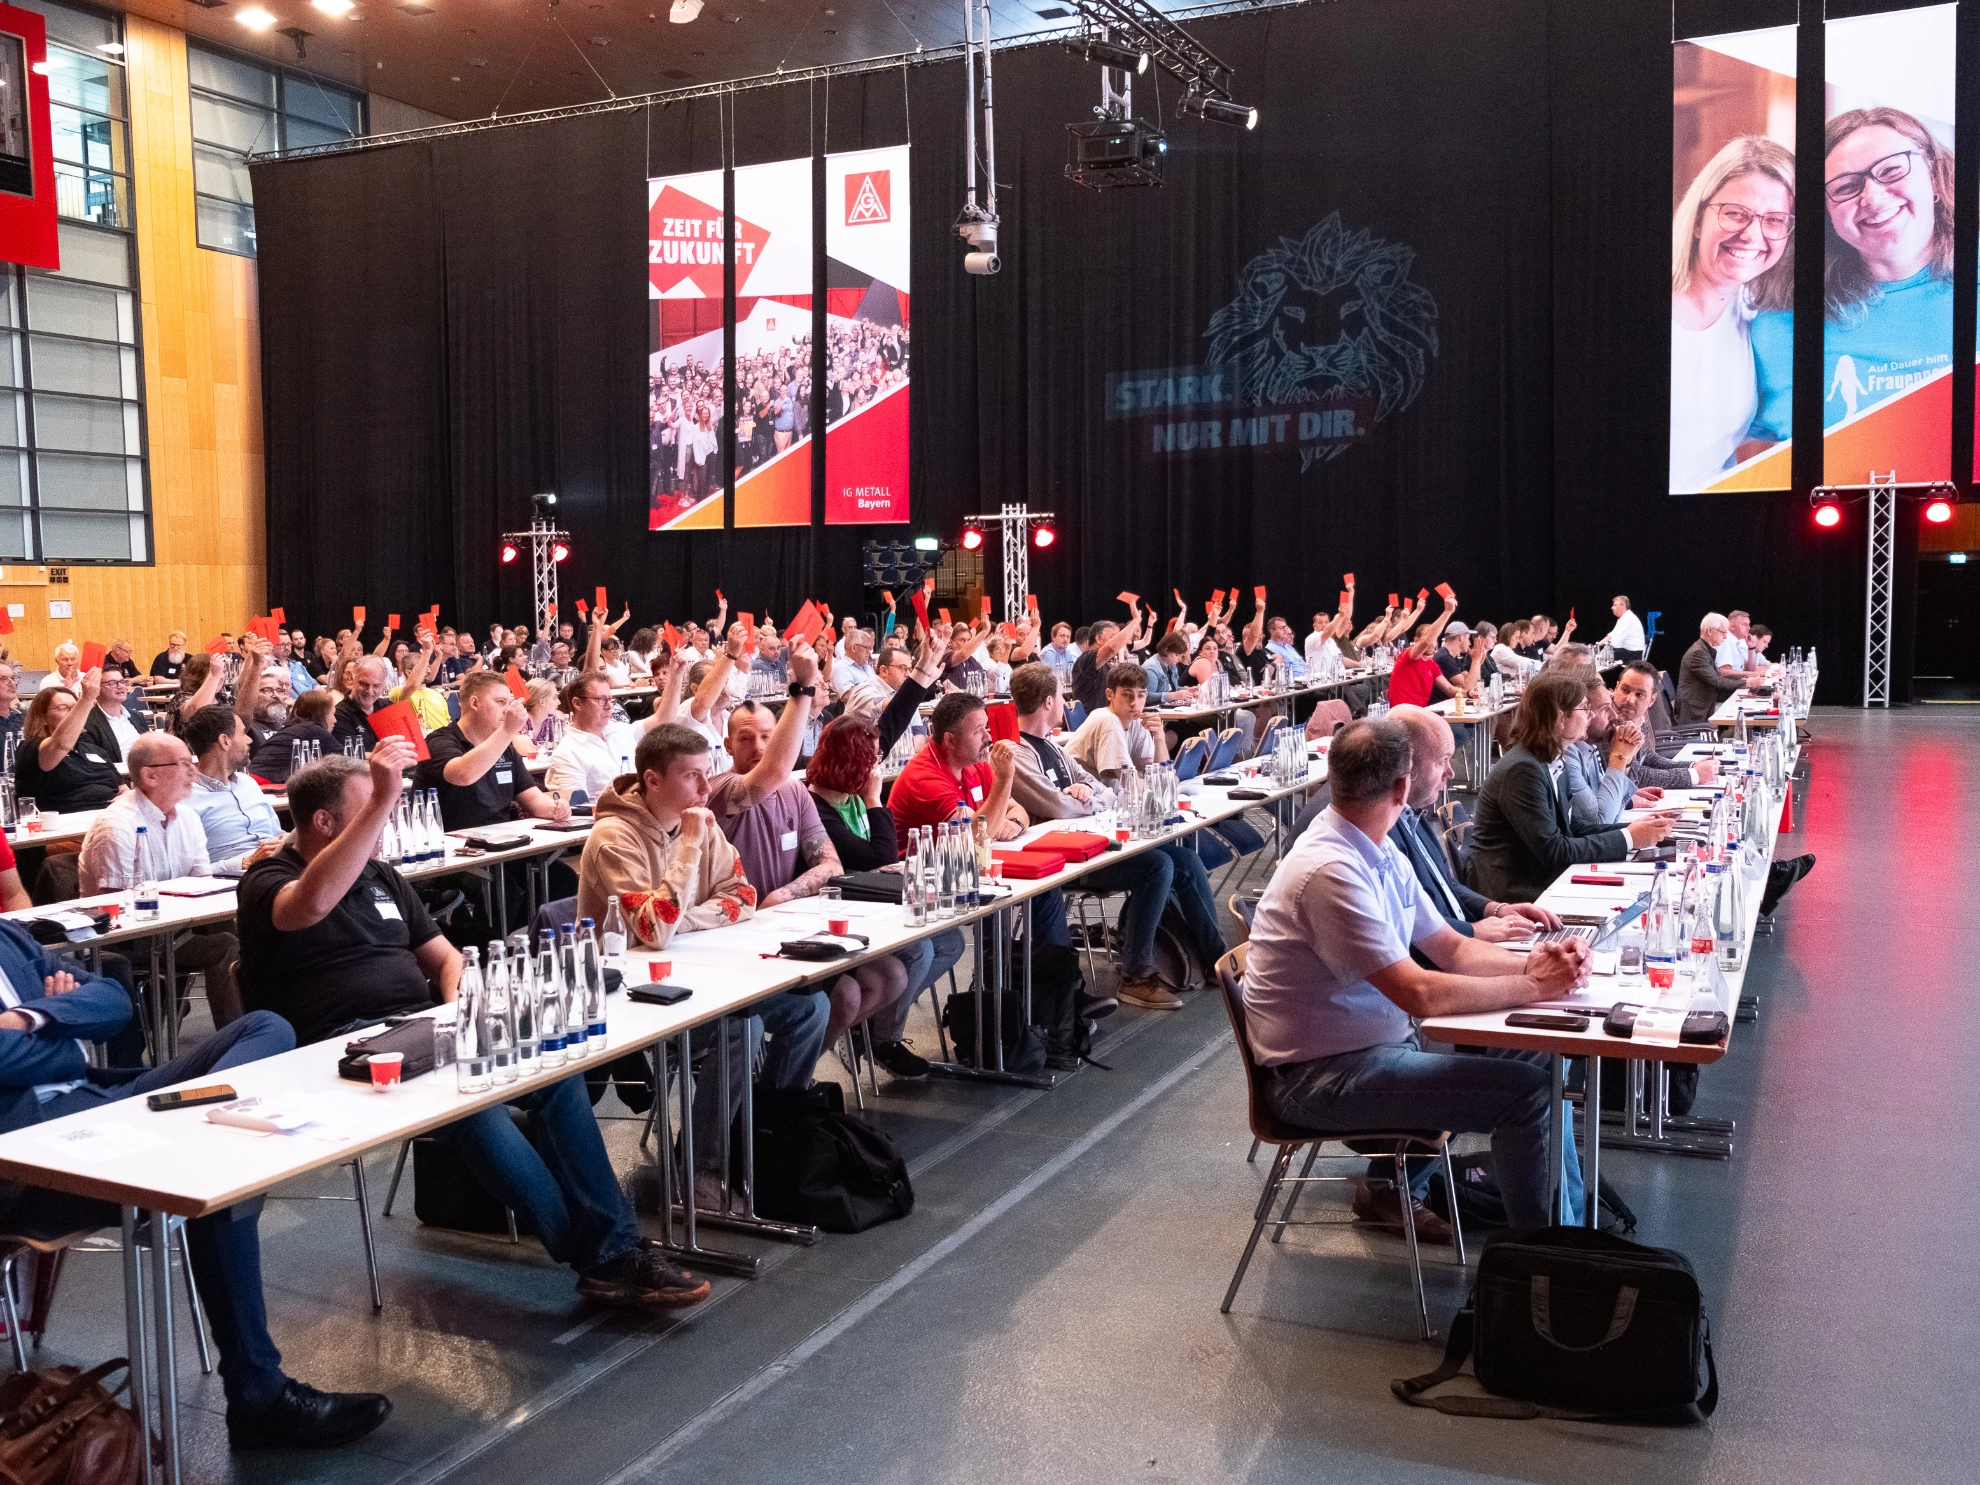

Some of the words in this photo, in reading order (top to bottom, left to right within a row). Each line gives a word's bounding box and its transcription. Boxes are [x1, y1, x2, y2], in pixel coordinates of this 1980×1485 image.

[663, 218, 702, 238] ZEIT
[707, 216, 743, 240] FÜR
[649, 240, 756, 265] ZUKUNFT
[1868, 363, 1888, 373] Auf
[1890, 358, 1923, 371] Dauer
[1925, 353, 1949, 364] hilft
[1115, 374, 1233, 411] STARK.
[1153, 420, 1222, 453] NUR
[1229, 414, 1291, 447] MIT
[1298, 409, 1366, 441] DIR.
[843, 488, 852, 497] IG
[855, 487, 891, 497] METALL
[858, 498, 891, 511] Bayern
[50, 568, 66, 576] EXIT
